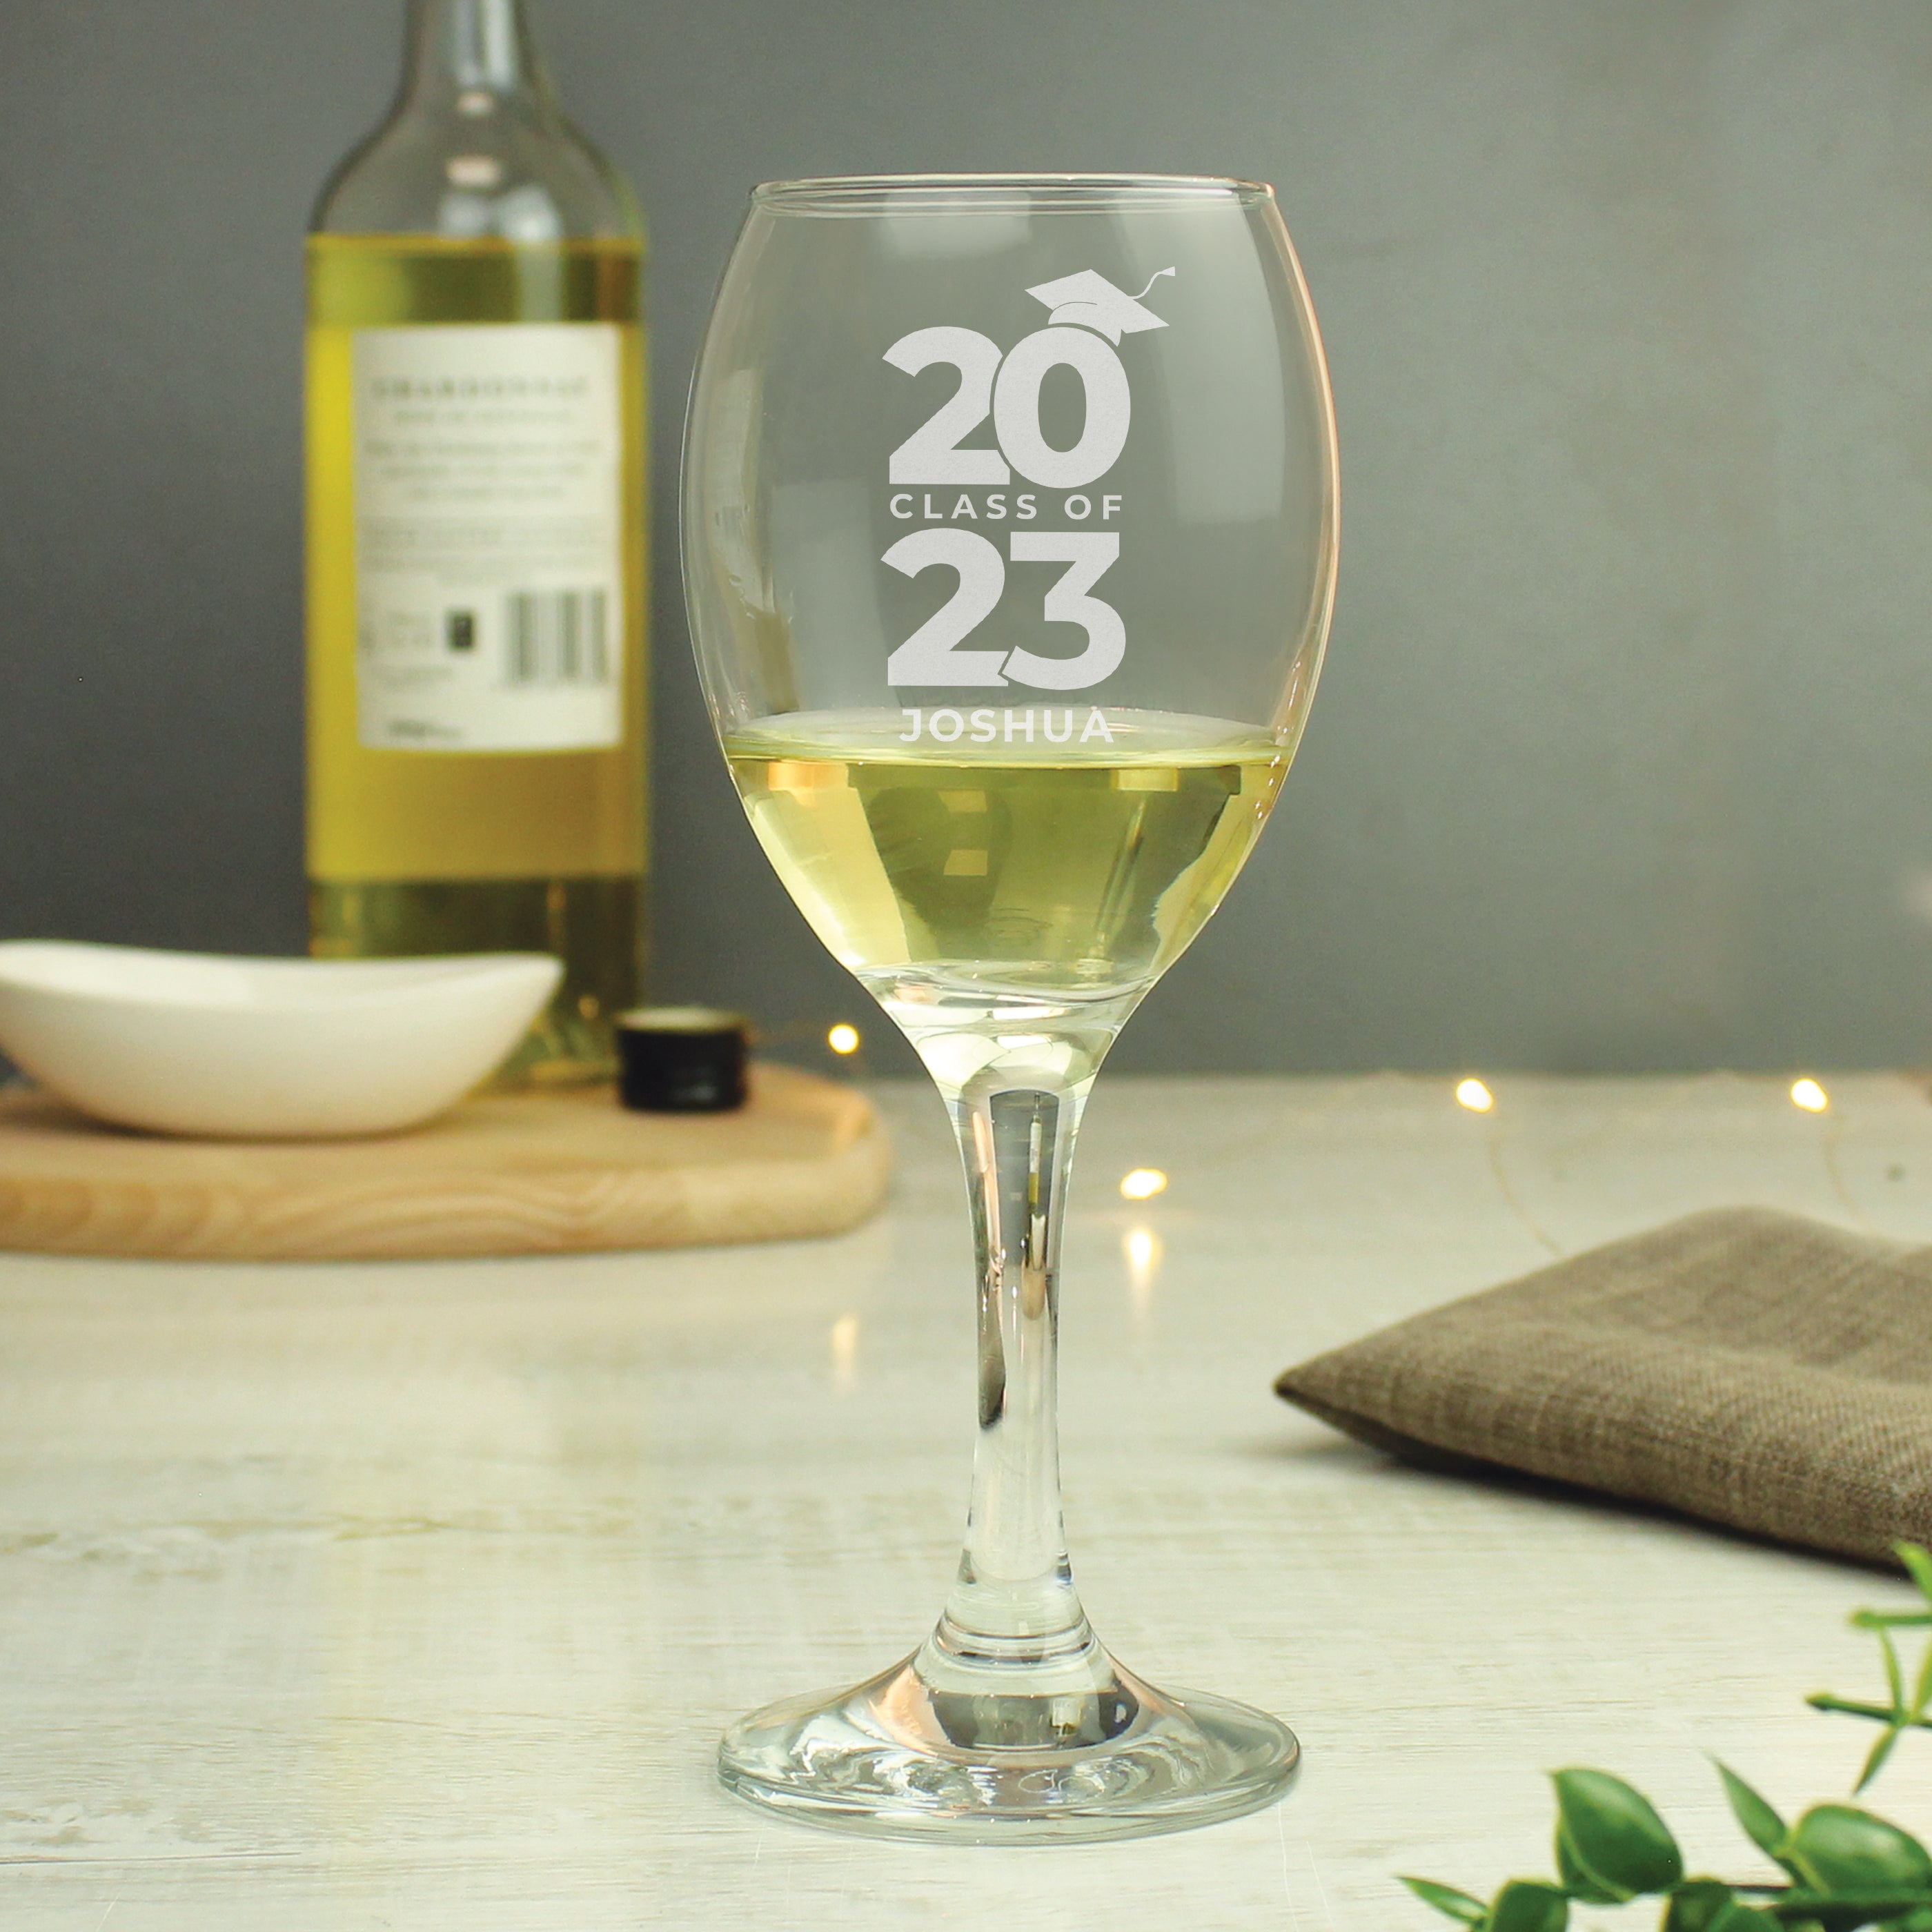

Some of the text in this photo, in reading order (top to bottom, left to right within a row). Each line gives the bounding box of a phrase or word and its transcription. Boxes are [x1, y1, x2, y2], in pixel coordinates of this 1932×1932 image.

[882, 326, 1131, 489] 20
[889, 493, 1123, 520] CLASS OF
[880, 528, 1126, 690] 23
[899, 709, 1114, 743] JOSHUA
